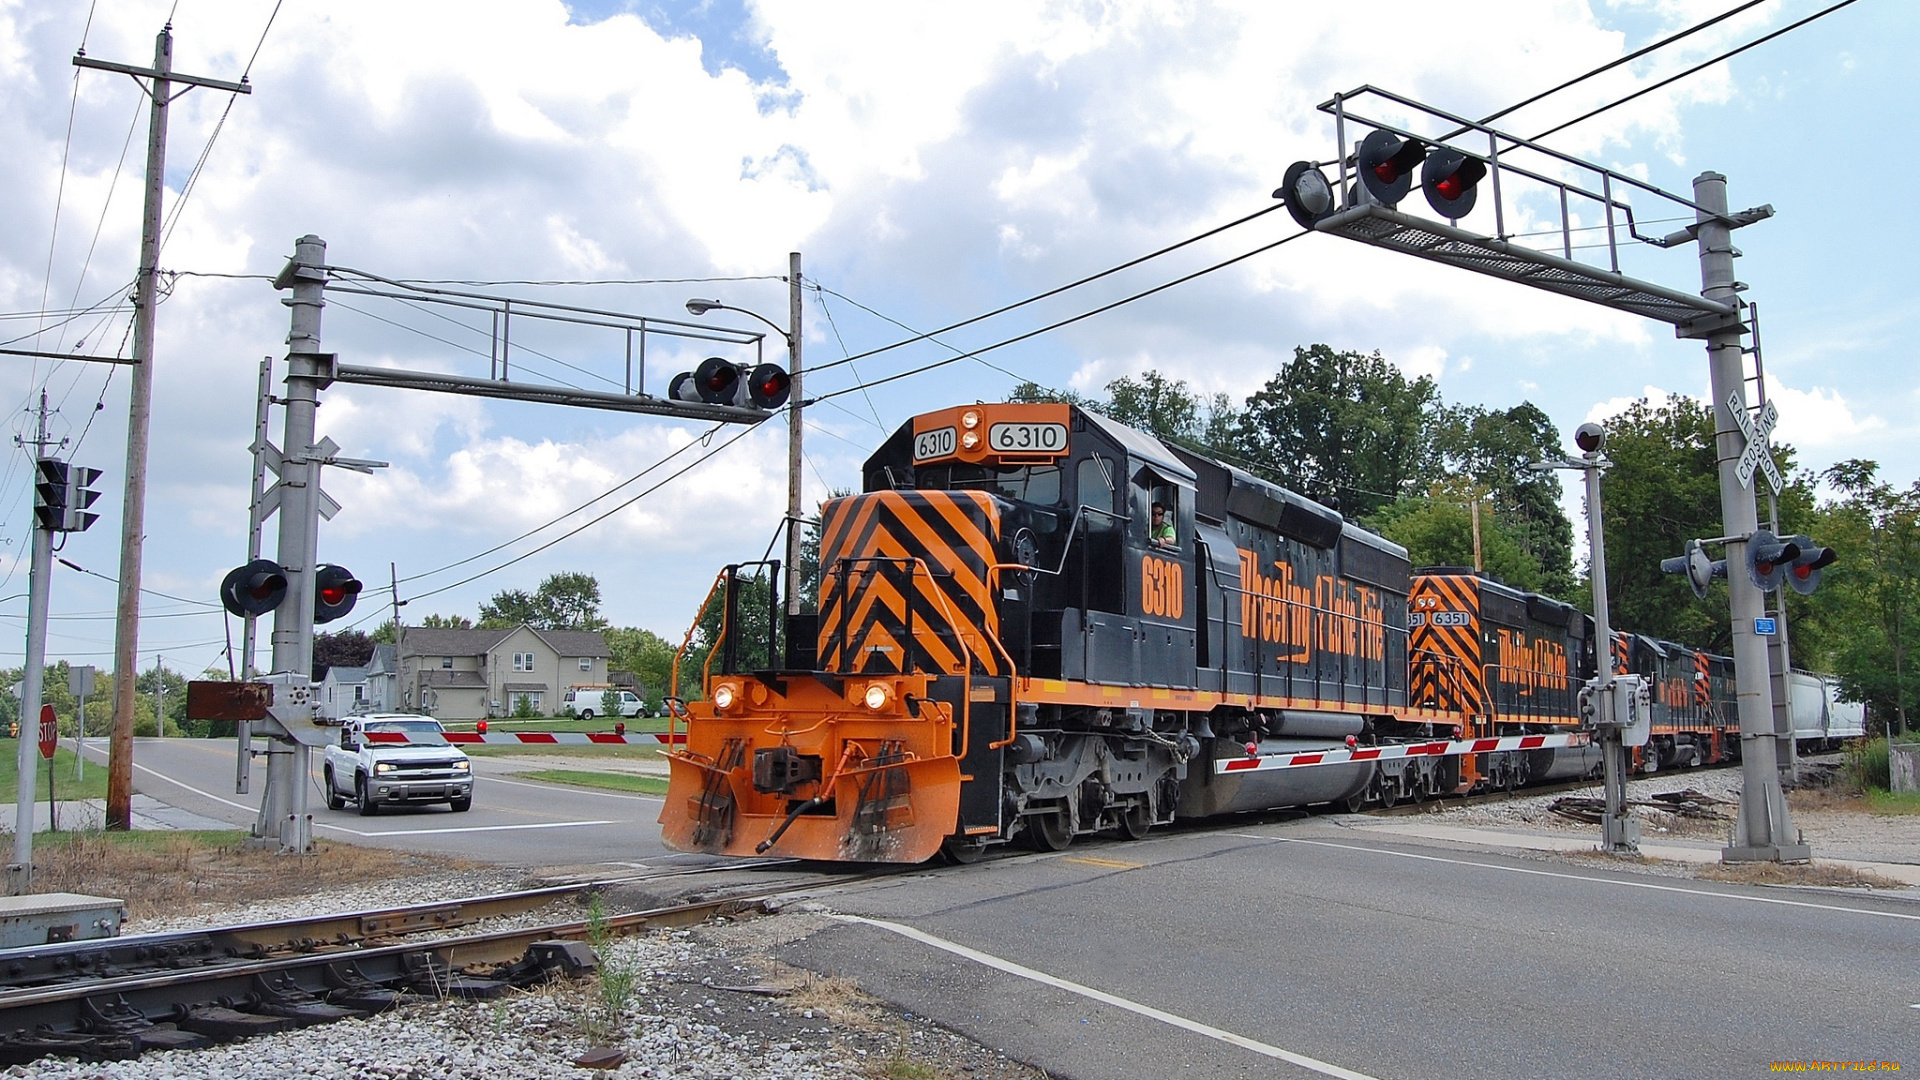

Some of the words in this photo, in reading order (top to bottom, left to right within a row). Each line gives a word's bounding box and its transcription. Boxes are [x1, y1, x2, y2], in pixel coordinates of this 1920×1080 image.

[1729, 395, 1750, 436] RAIL
[919, 430, 952, 457] 6310
[1000, 426, 1058, 448] 6310
[1739, 407, 1776, 481] CROSSING
[1760, 451, 1781, 490] ROAD
[1142, 556, 1182, 620] 6310
[1434, 613, 1466, 625] 6351
[39, 721, 57, 743] STOP
